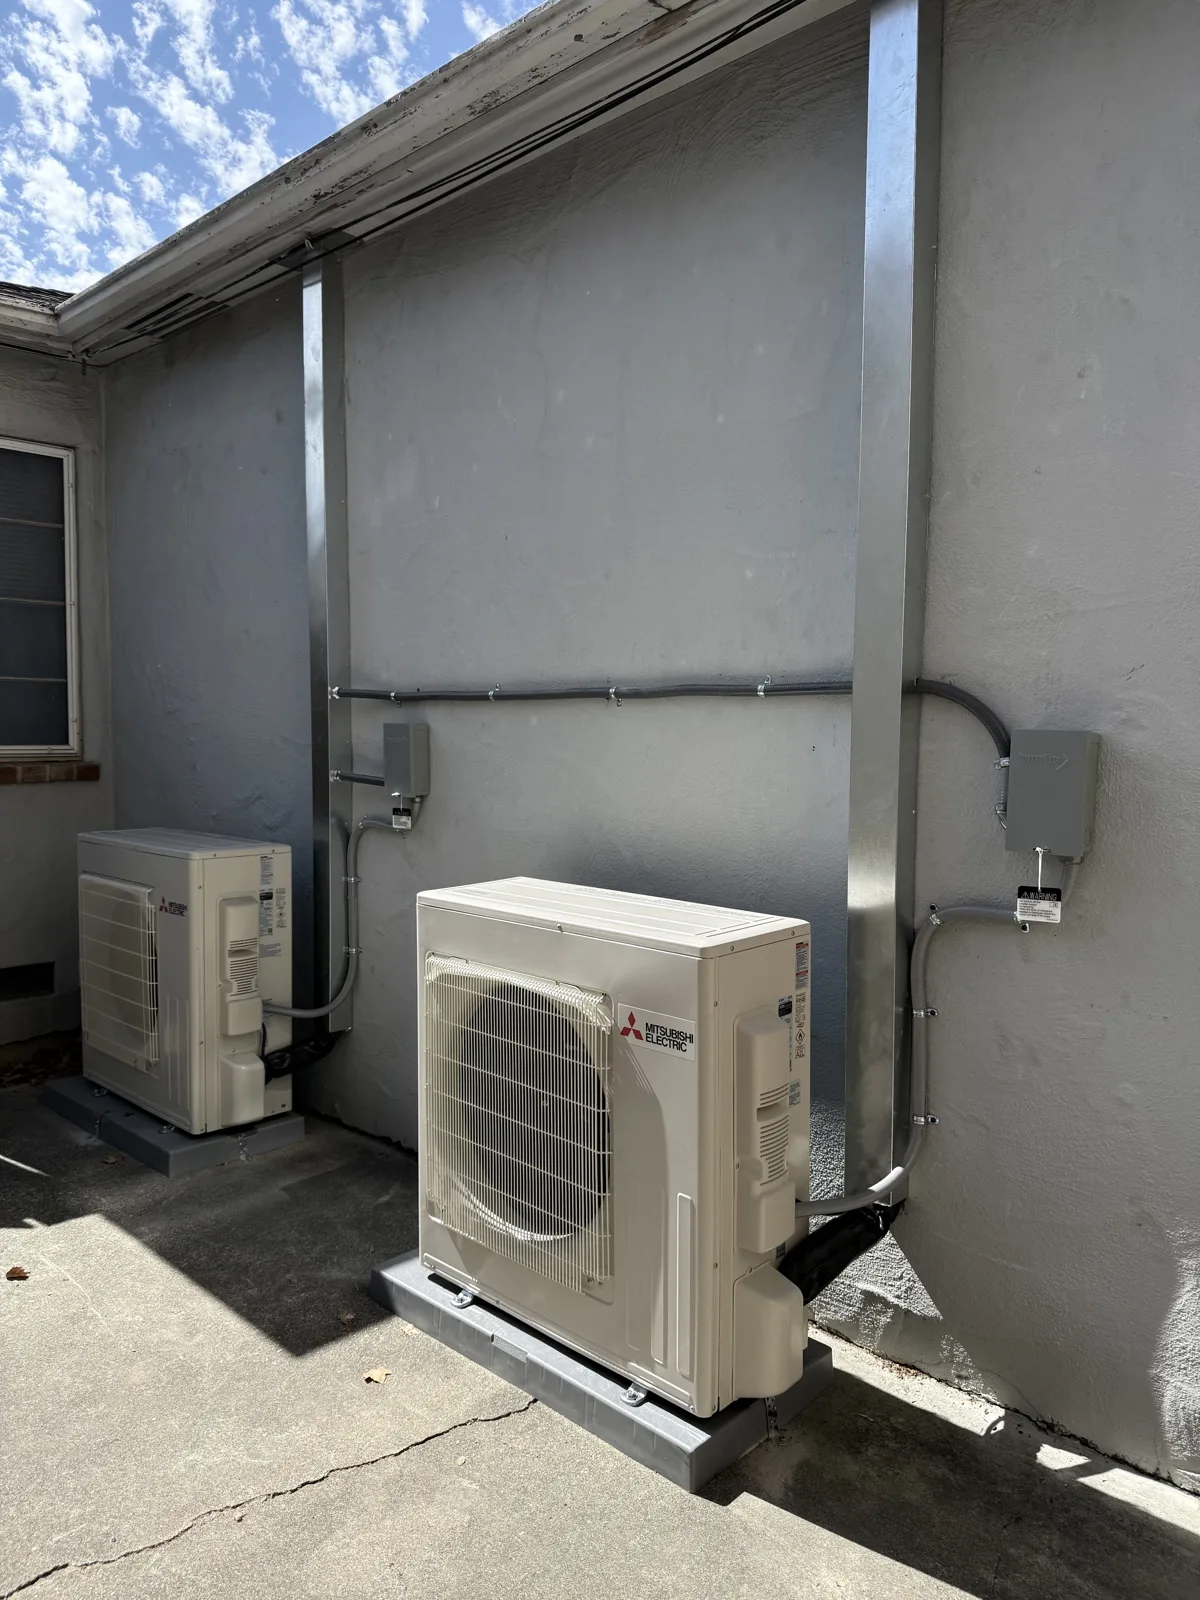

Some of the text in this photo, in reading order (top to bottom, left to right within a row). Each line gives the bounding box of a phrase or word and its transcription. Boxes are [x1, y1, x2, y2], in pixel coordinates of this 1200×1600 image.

[1030, 892, 1057, 901] WARNING
[645, 1022, 694, 1044] MITSUBISHI
[645, 1033, 687, 1053] ELECTRIC
